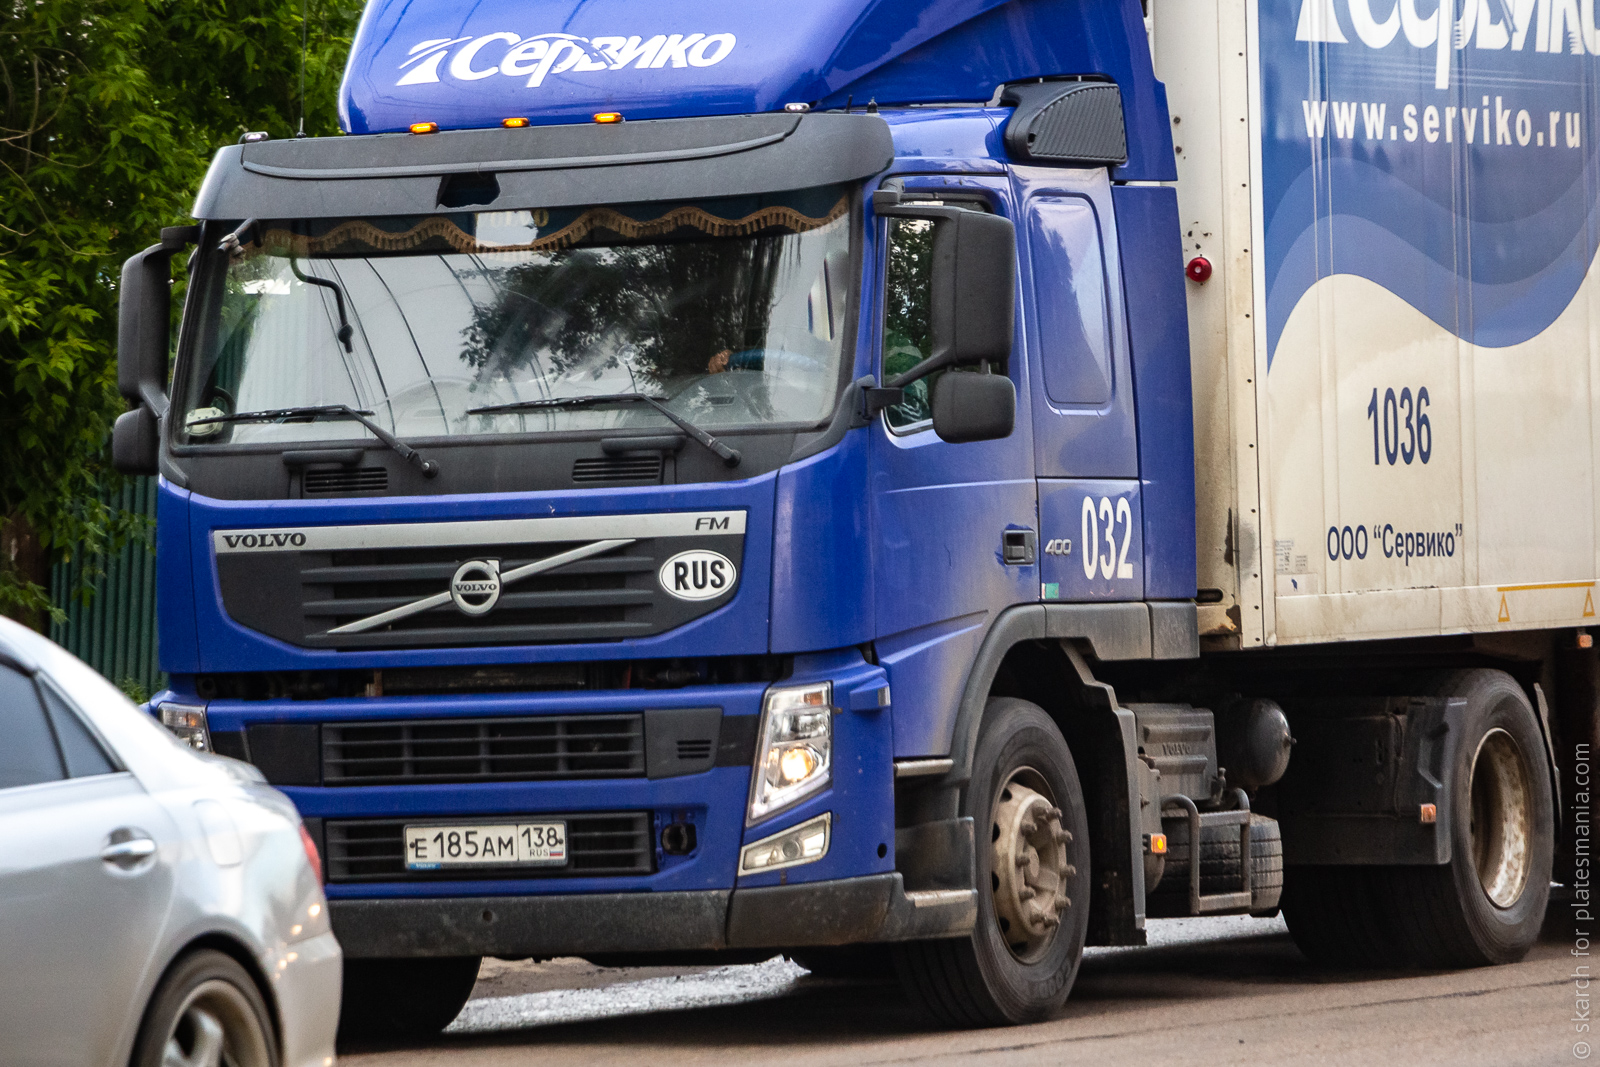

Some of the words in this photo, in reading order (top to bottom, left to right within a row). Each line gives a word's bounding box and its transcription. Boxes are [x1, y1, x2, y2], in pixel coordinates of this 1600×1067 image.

[449, 31, 737, 88] Сервико
[1302, 95, 1581, 149] www.serviko.ru
[1367, 386, 1432, 466] 1036
[695, 516, 730, 531] FM
[222, 532, 307, 549] VOLVO
[1044, 538, 1072, 556] 400
[1081, 495, 1134, 580] 032
[1327, 523, 1369, 562] ООО
[454, 583, 498, 592] VOLVO
[674, 559, 726, 591] RUS
[521, 827, 558, 848] 138
[529, 849, 549, 857] RUS
